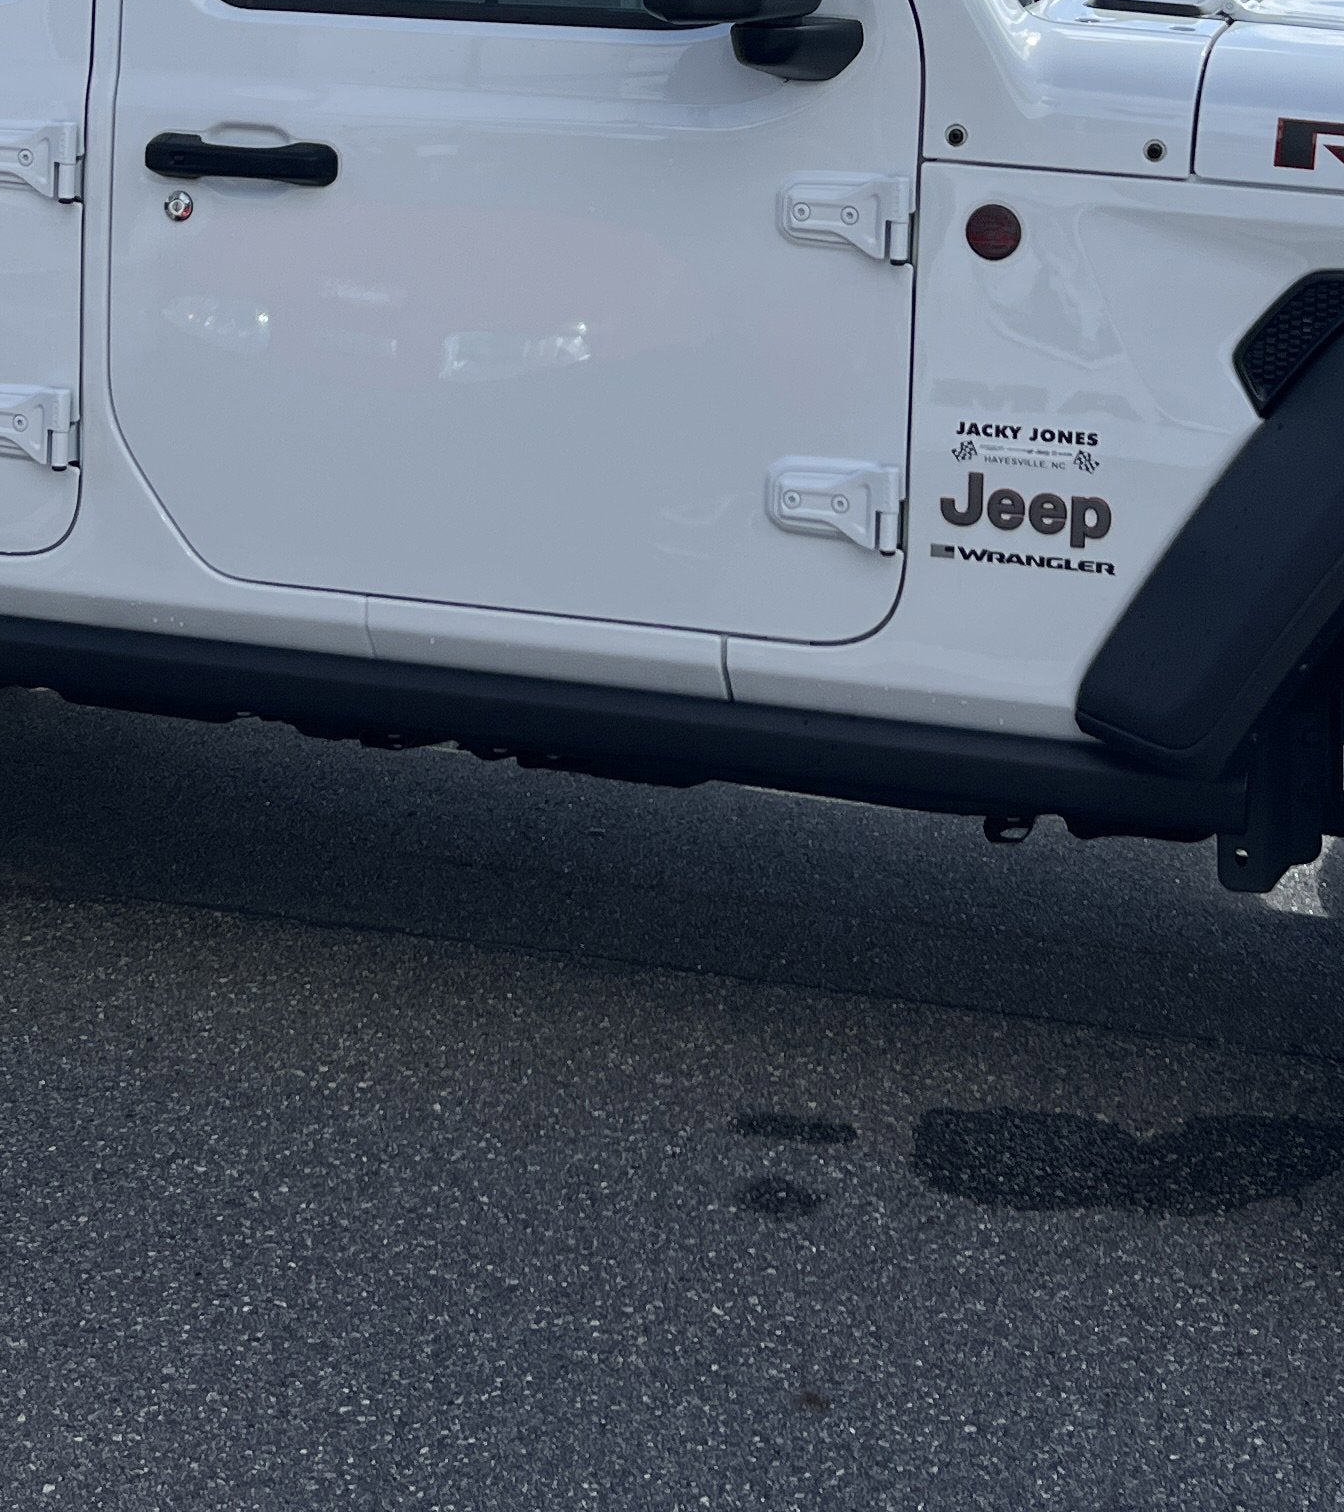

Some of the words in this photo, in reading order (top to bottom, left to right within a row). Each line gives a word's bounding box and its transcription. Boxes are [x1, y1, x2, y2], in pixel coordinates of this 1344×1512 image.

[956, 421, 1022, 439] JACKY
[1028, 428, 1099, 446] JONES
[1051, 461, 1066, 470] NC
[940, 471, 1112, 549] Jeep
[958, 546, 1116, 576] WRANGLER
